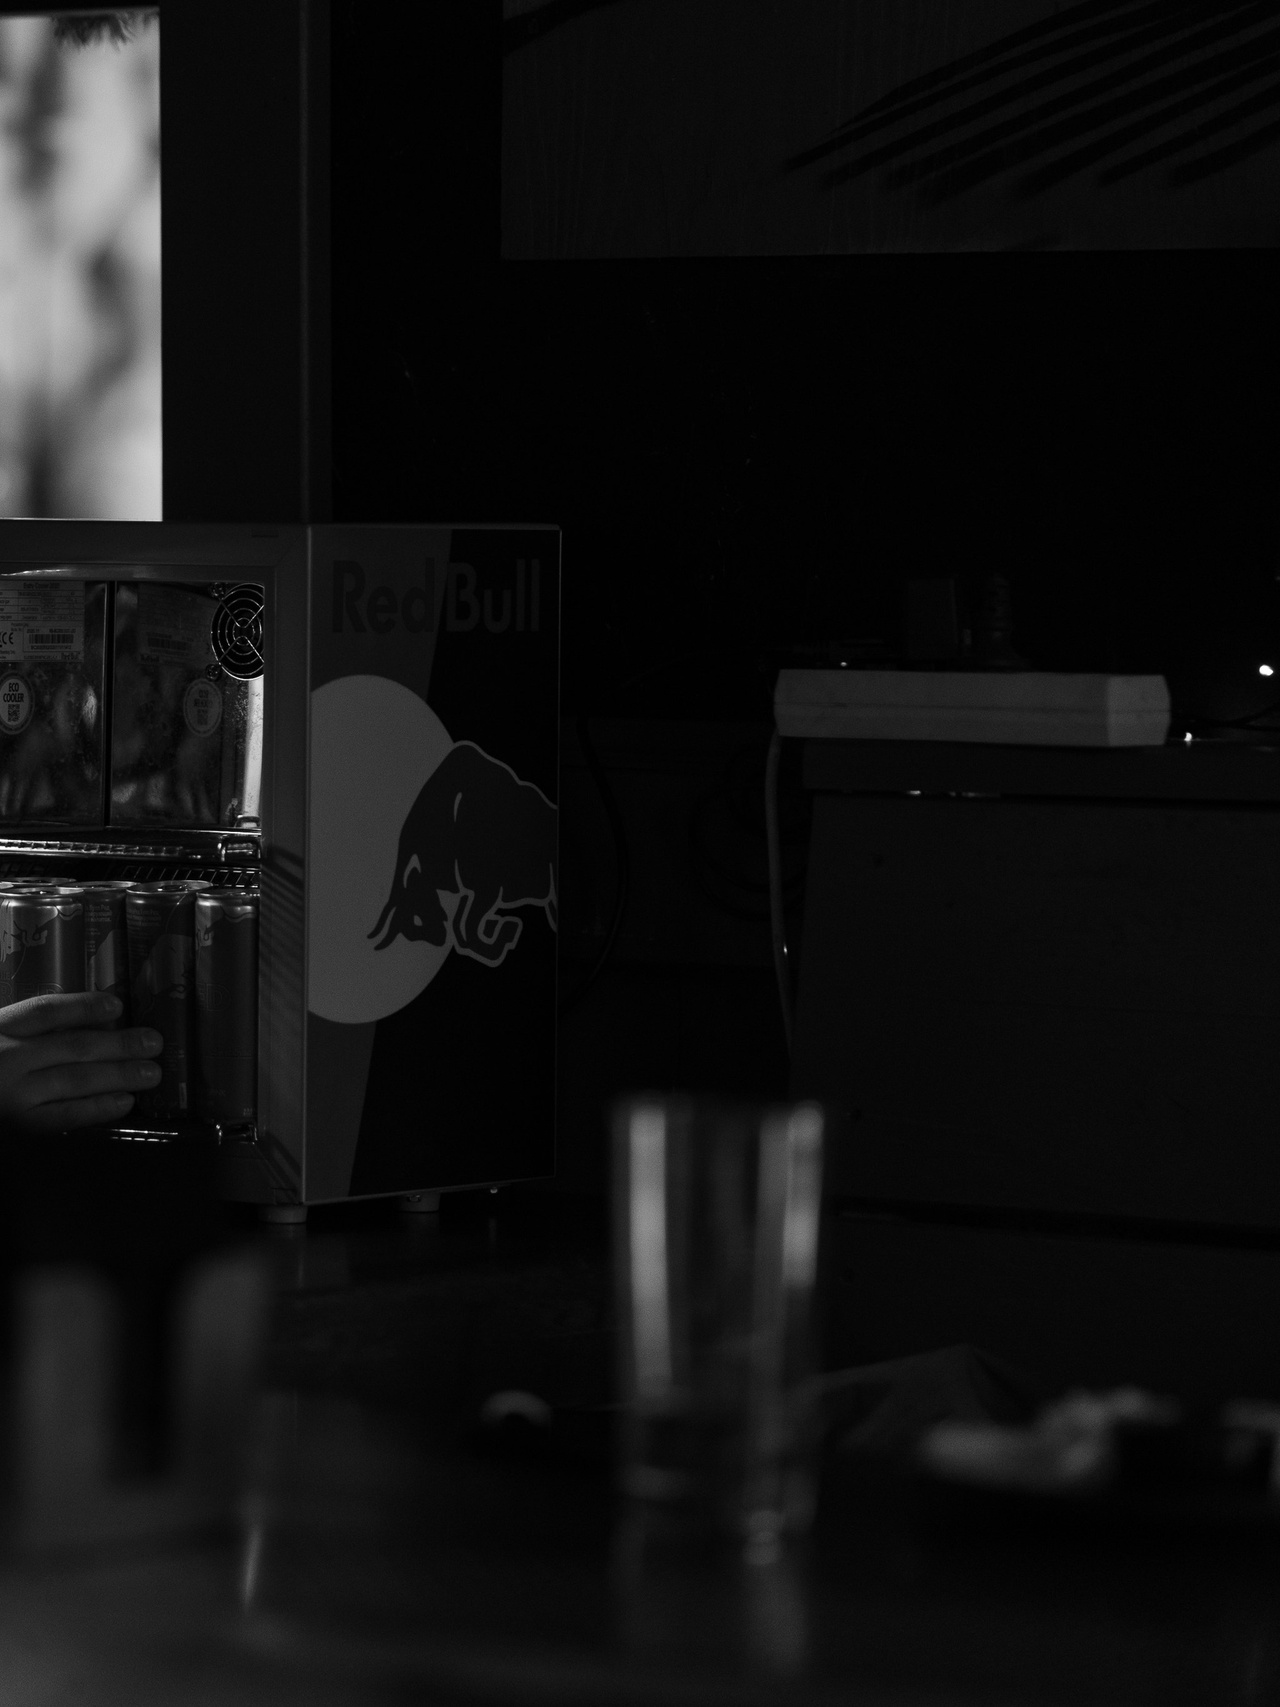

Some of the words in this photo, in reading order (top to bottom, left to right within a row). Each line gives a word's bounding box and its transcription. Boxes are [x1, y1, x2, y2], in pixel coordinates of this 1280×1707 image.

[332, 557, 435, 634] Red
[446, 558, 541, 634] Bull
[8, 683, 20, 692] ECO
[3, 693, 24, 703] COOLER
